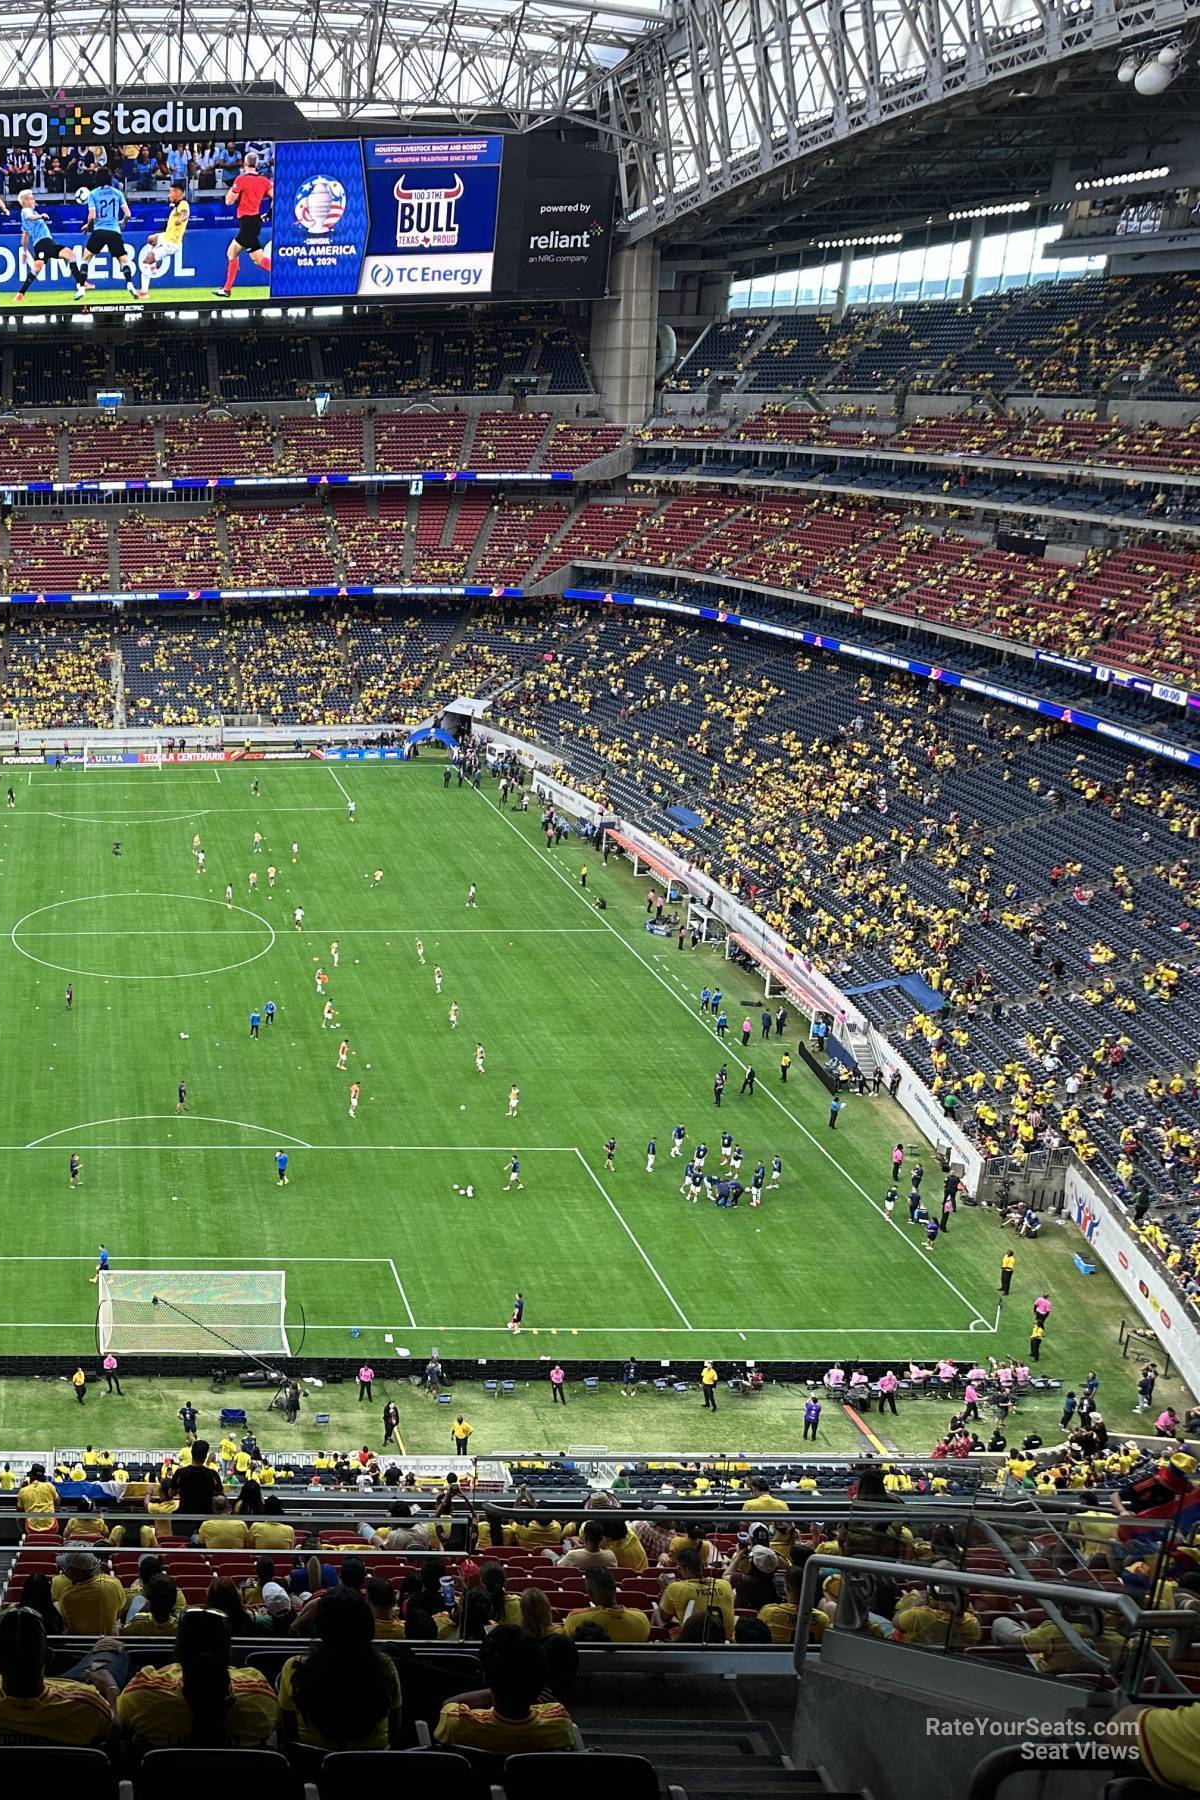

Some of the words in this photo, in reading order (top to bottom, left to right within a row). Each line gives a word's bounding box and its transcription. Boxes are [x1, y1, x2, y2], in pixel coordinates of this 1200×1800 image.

[92, 101, 242, 135] stadium
[431, 191, 443, 200] THE
[100, 199, 117, 218] 21
[540, 204, 578, 215] powered
[580, 203, 591, 214] by
[399, 201, 457, 234] BULL
[398, 235, 419, 245] TEXAS
[432, 234, 456, 244] PROUD
[530, 230, 590, 249] reliant
[279, 246, 307, 256] COPA
[297, 258, 314, 266] USA
[316, 257, 337, 265] 2024
[538, 255, 554, 263] NRG
[555, 255, 588, 264] company
[397, 267, 417, 283] TC
[420, 266, 483, 285] Energy
[3, 756, 46, 765] POWERADE
[95, 755, 123, 763] ULTRA
[177, 752, 226, 761] CENTENARIO
